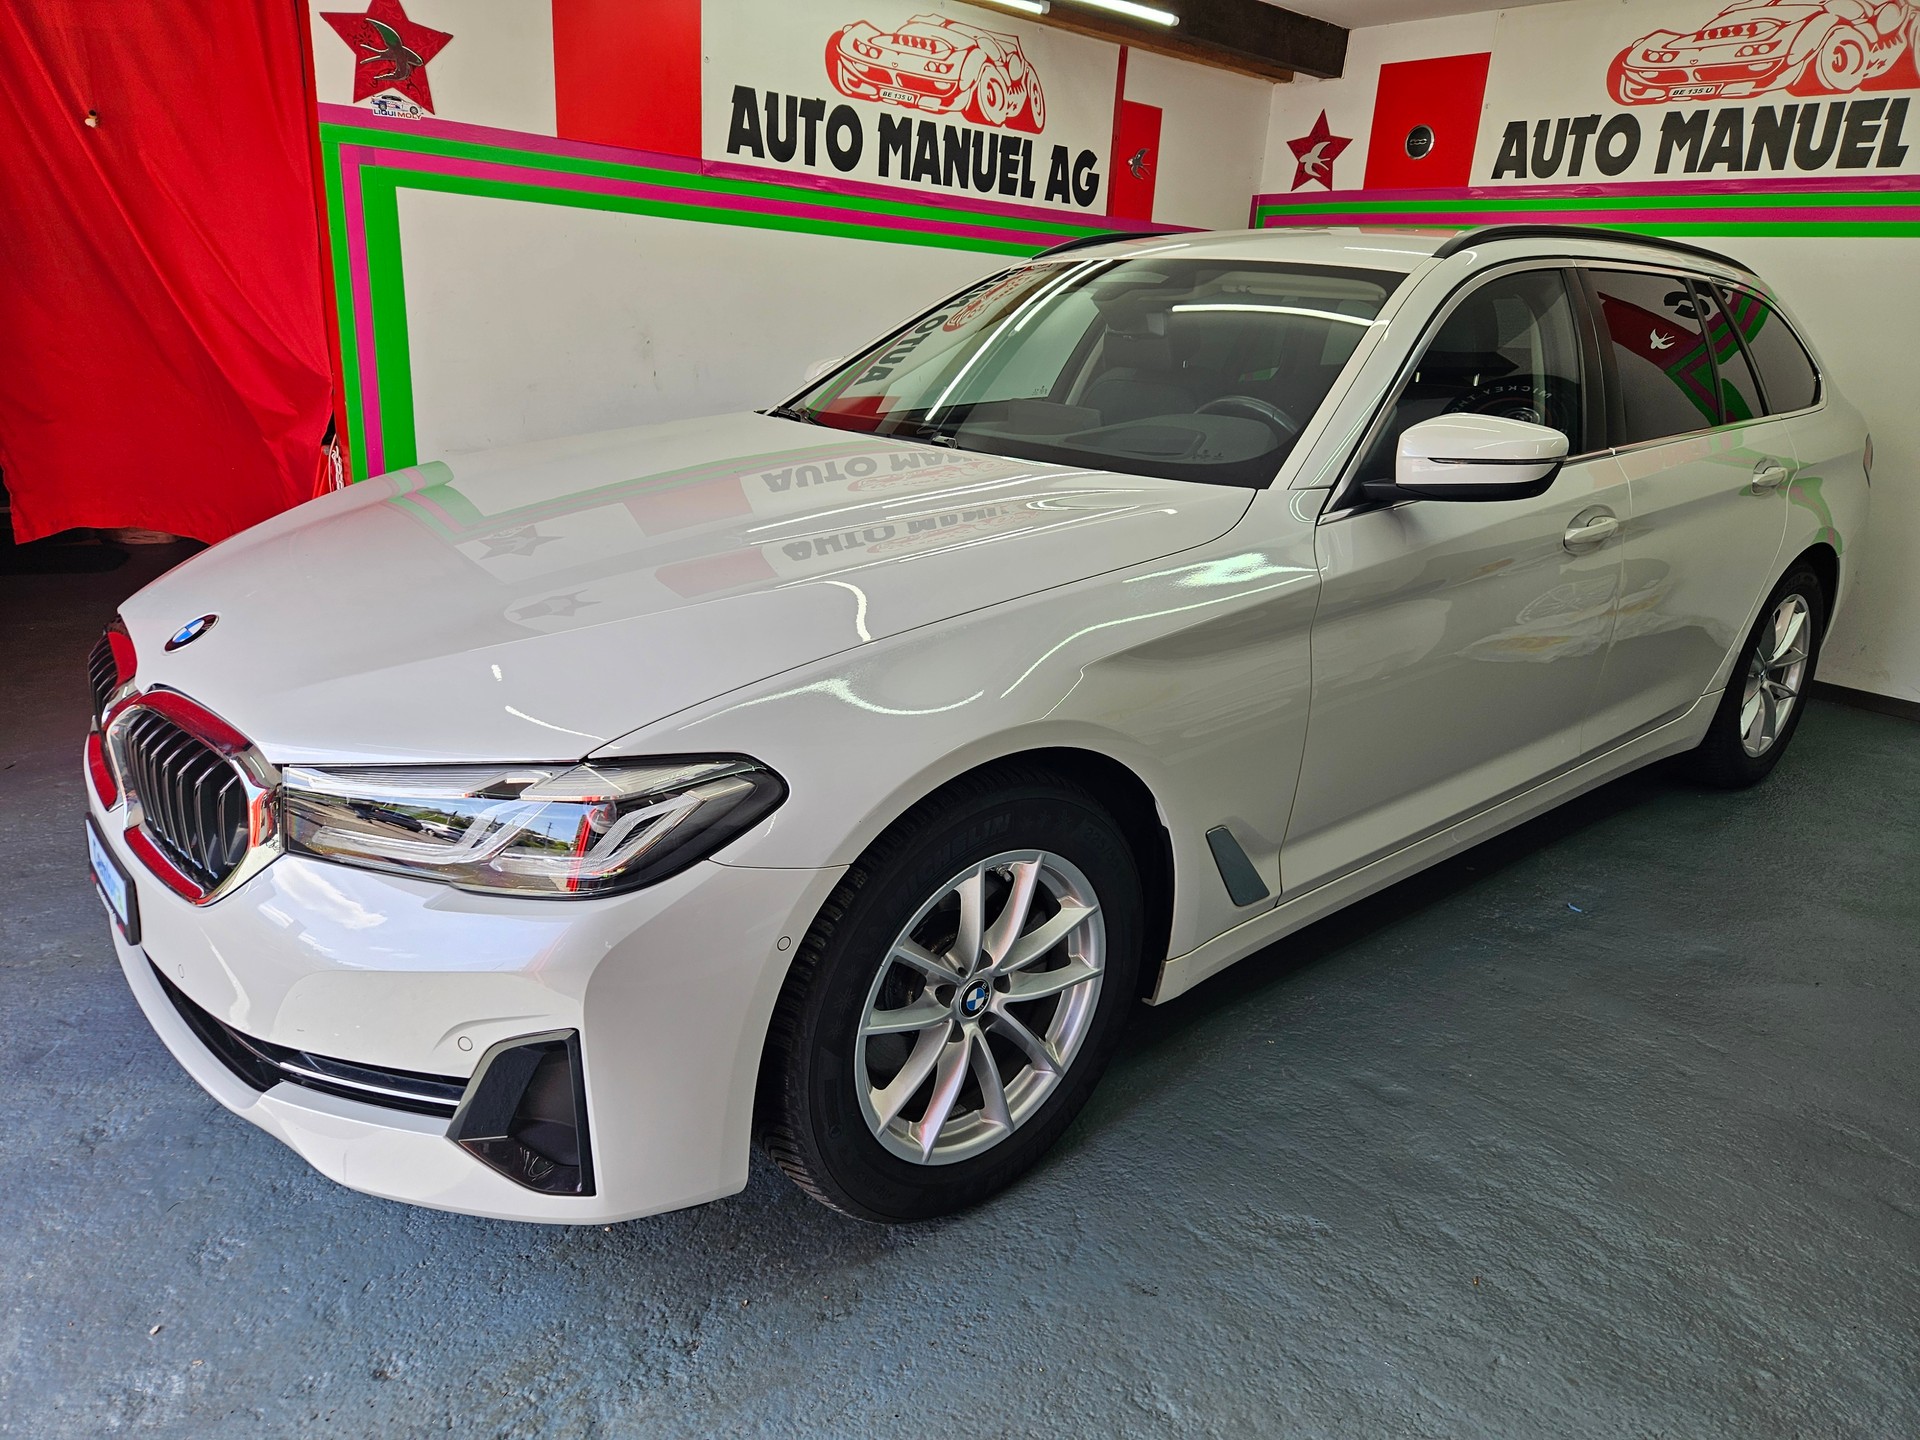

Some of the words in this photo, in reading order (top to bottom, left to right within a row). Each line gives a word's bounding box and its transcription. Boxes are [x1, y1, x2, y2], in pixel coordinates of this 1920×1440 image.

[373, 108, 396, 117] LIQUI
[397, 111, 421, 119] MOLY
[727, 85, 863, 172] AUTO
[878, 112, 1036, 199] MANUEL
[1044, 144, 1100, 207] AG
[1491, 113, 1641, 179] AUTO
[1654, 97, 1911, 174] MANUEL
